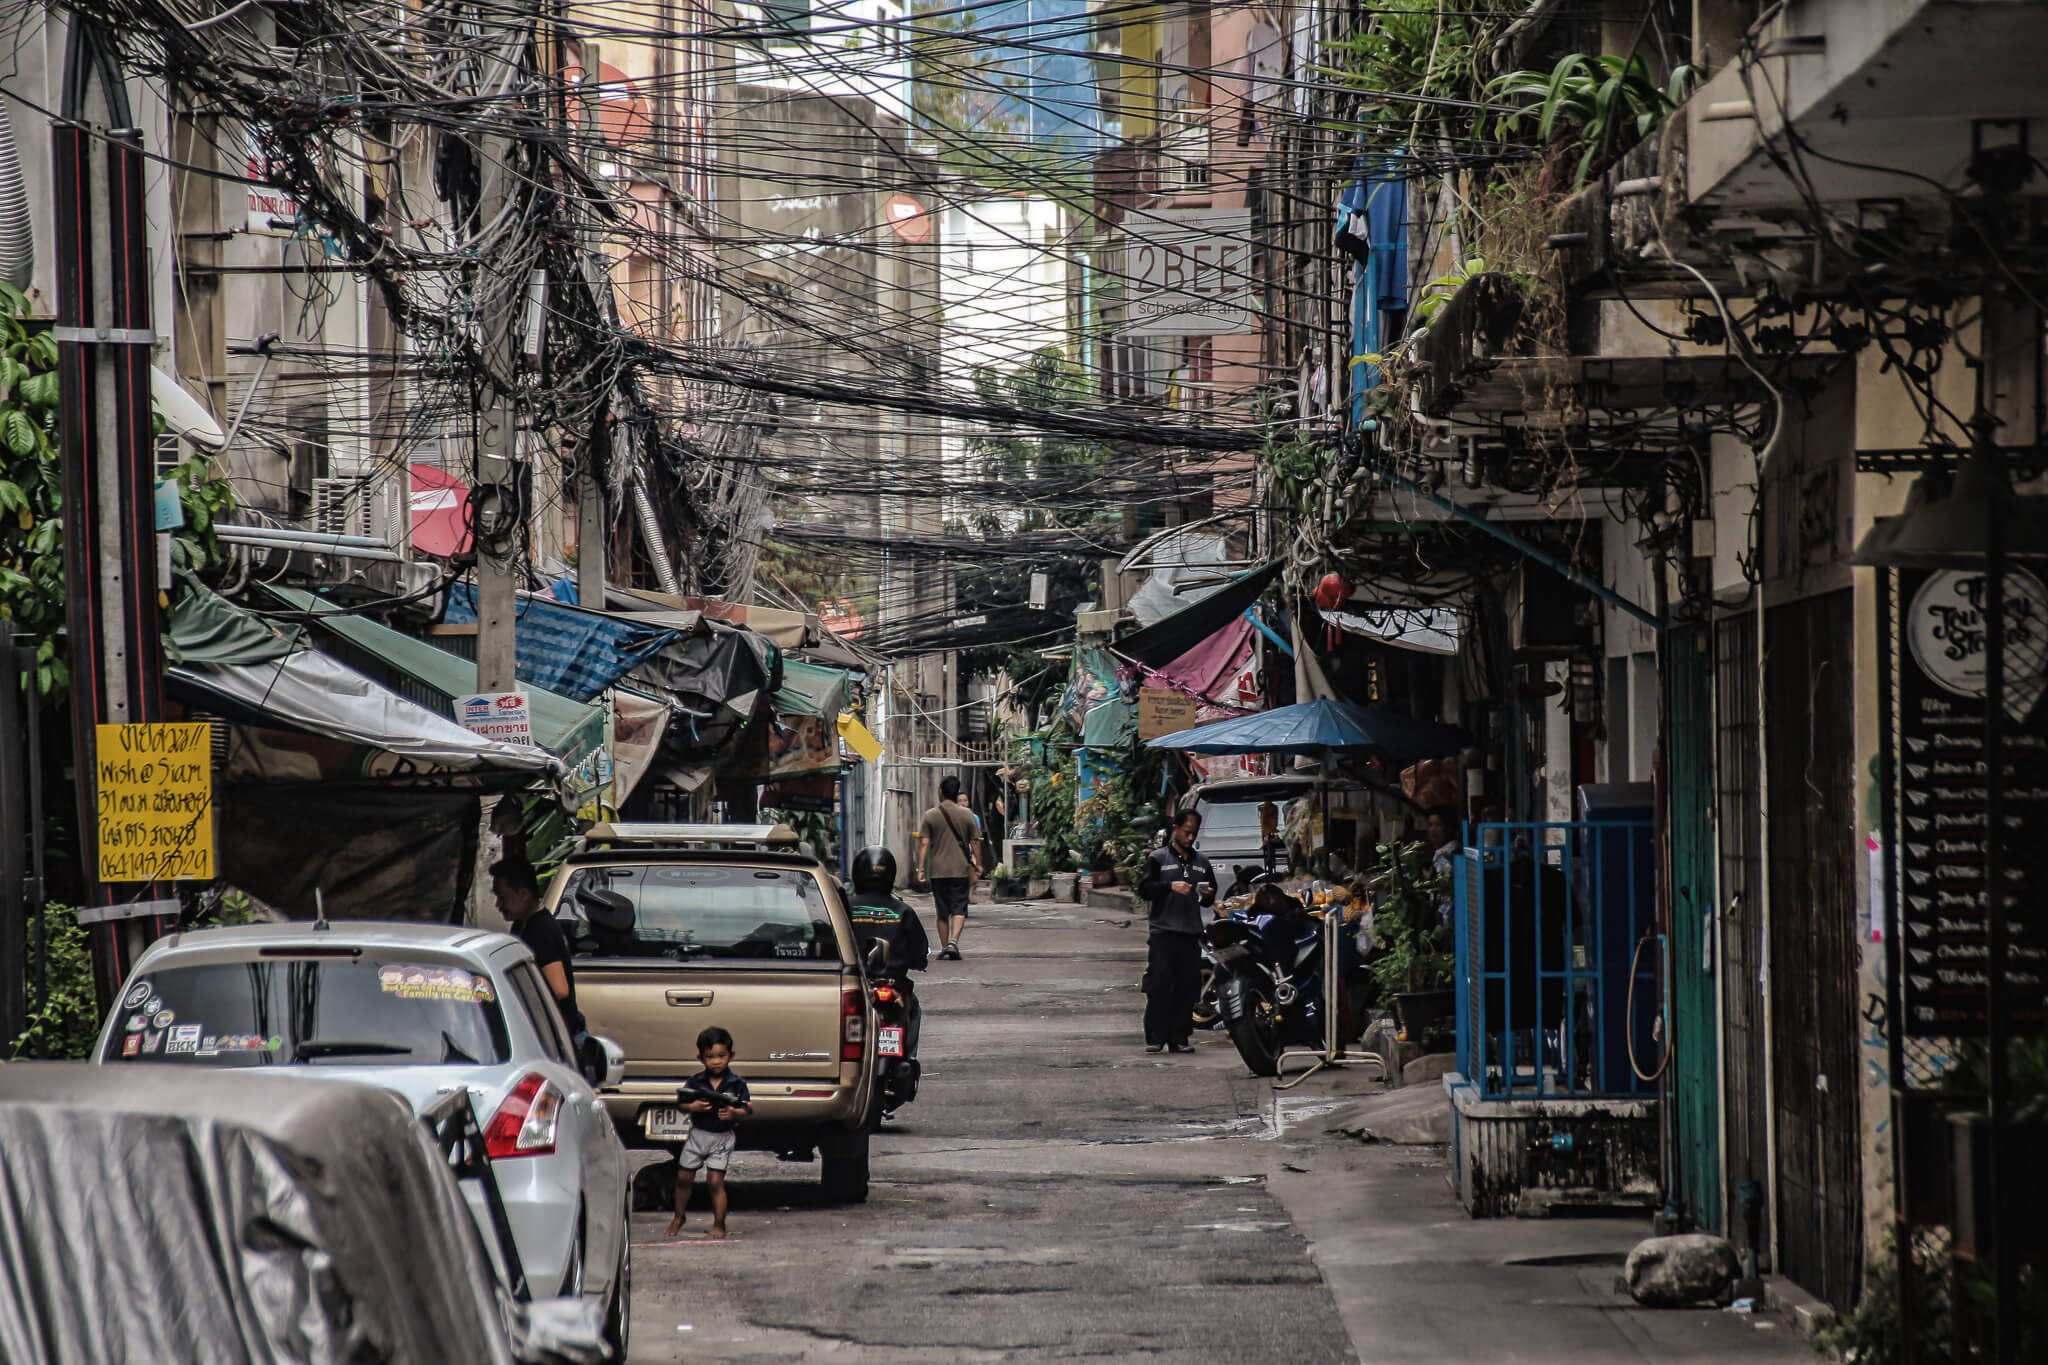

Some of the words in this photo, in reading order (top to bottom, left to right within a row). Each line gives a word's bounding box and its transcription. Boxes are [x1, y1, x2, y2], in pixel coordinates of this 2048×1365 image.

[1138, 244, 1238, 293] 2BEE
[1138, 301, 1189, 315] school
[1196, 301, 1210, 315] of
[1217, 301, 1238, 315] art
[403, 990, 440, 999] Family
[168, 1040, 196, 1053] BKK
